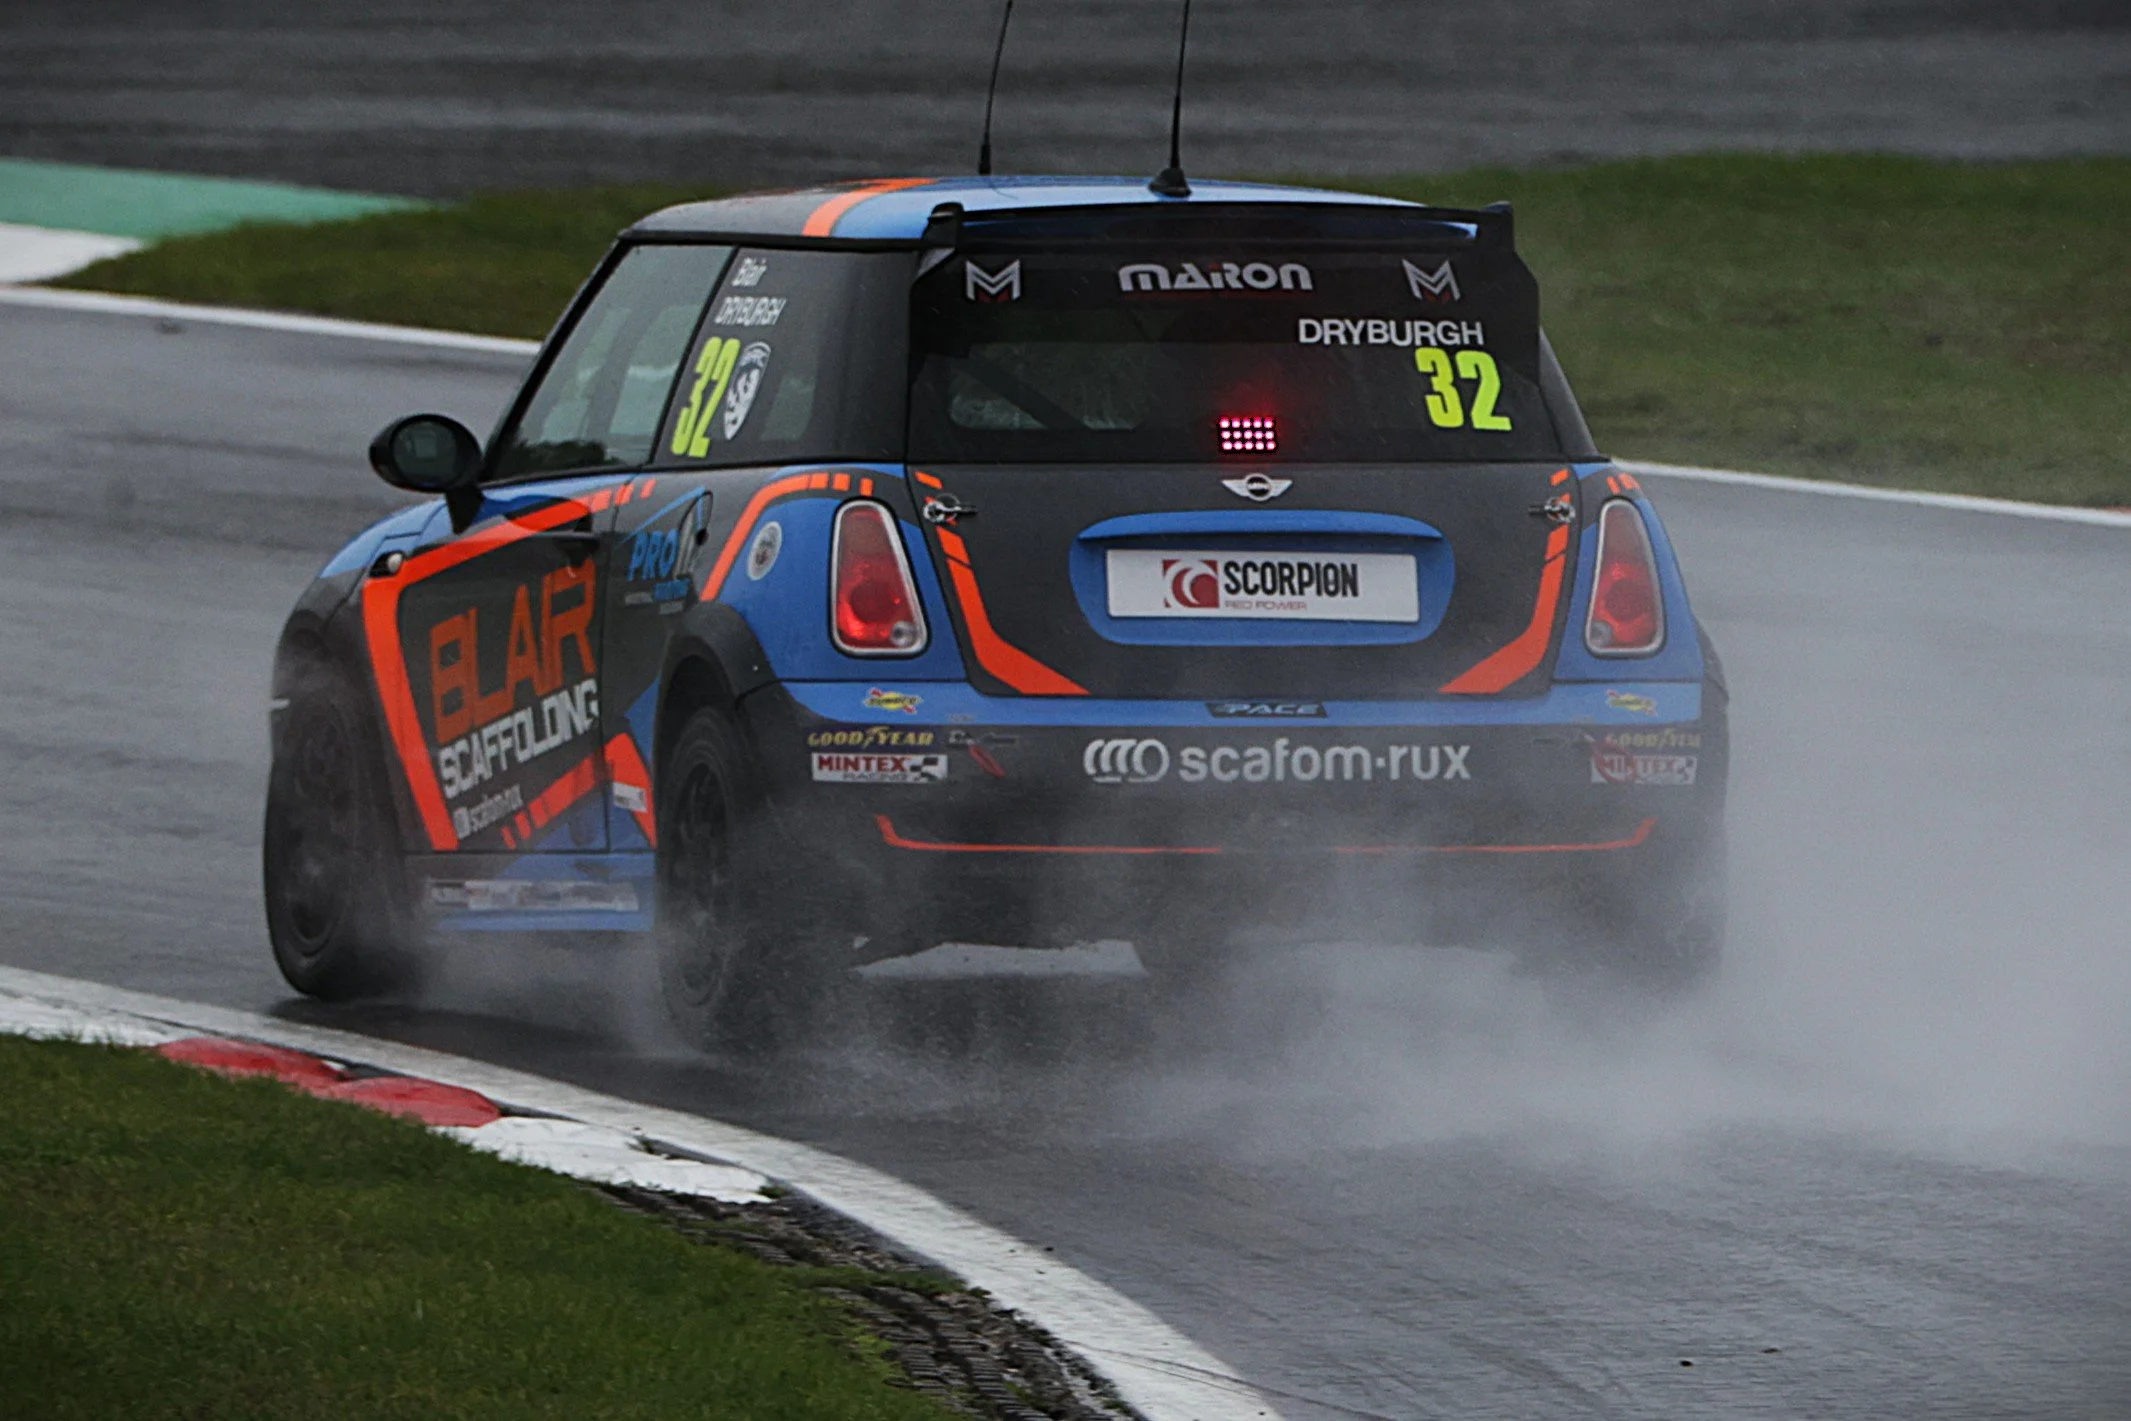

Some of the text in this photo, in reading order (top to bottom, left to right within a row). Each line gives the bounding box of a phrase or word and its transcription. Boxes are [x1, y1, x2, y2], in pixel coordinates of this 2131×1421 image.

[1298, 318, 1485, 346] DRYBURGH
[670, 335, 742, 459] 32
[1414, 346, 1513, 431] 32
[626, 528, 680, 583] PRO
[1223, 560, 1360, 598] SCORPION
[430, 556, 598, 745] BLAIR
[438, 678, 600, 800] SCAFFOLDING
[818, 755, 910, 773] MINTEX
